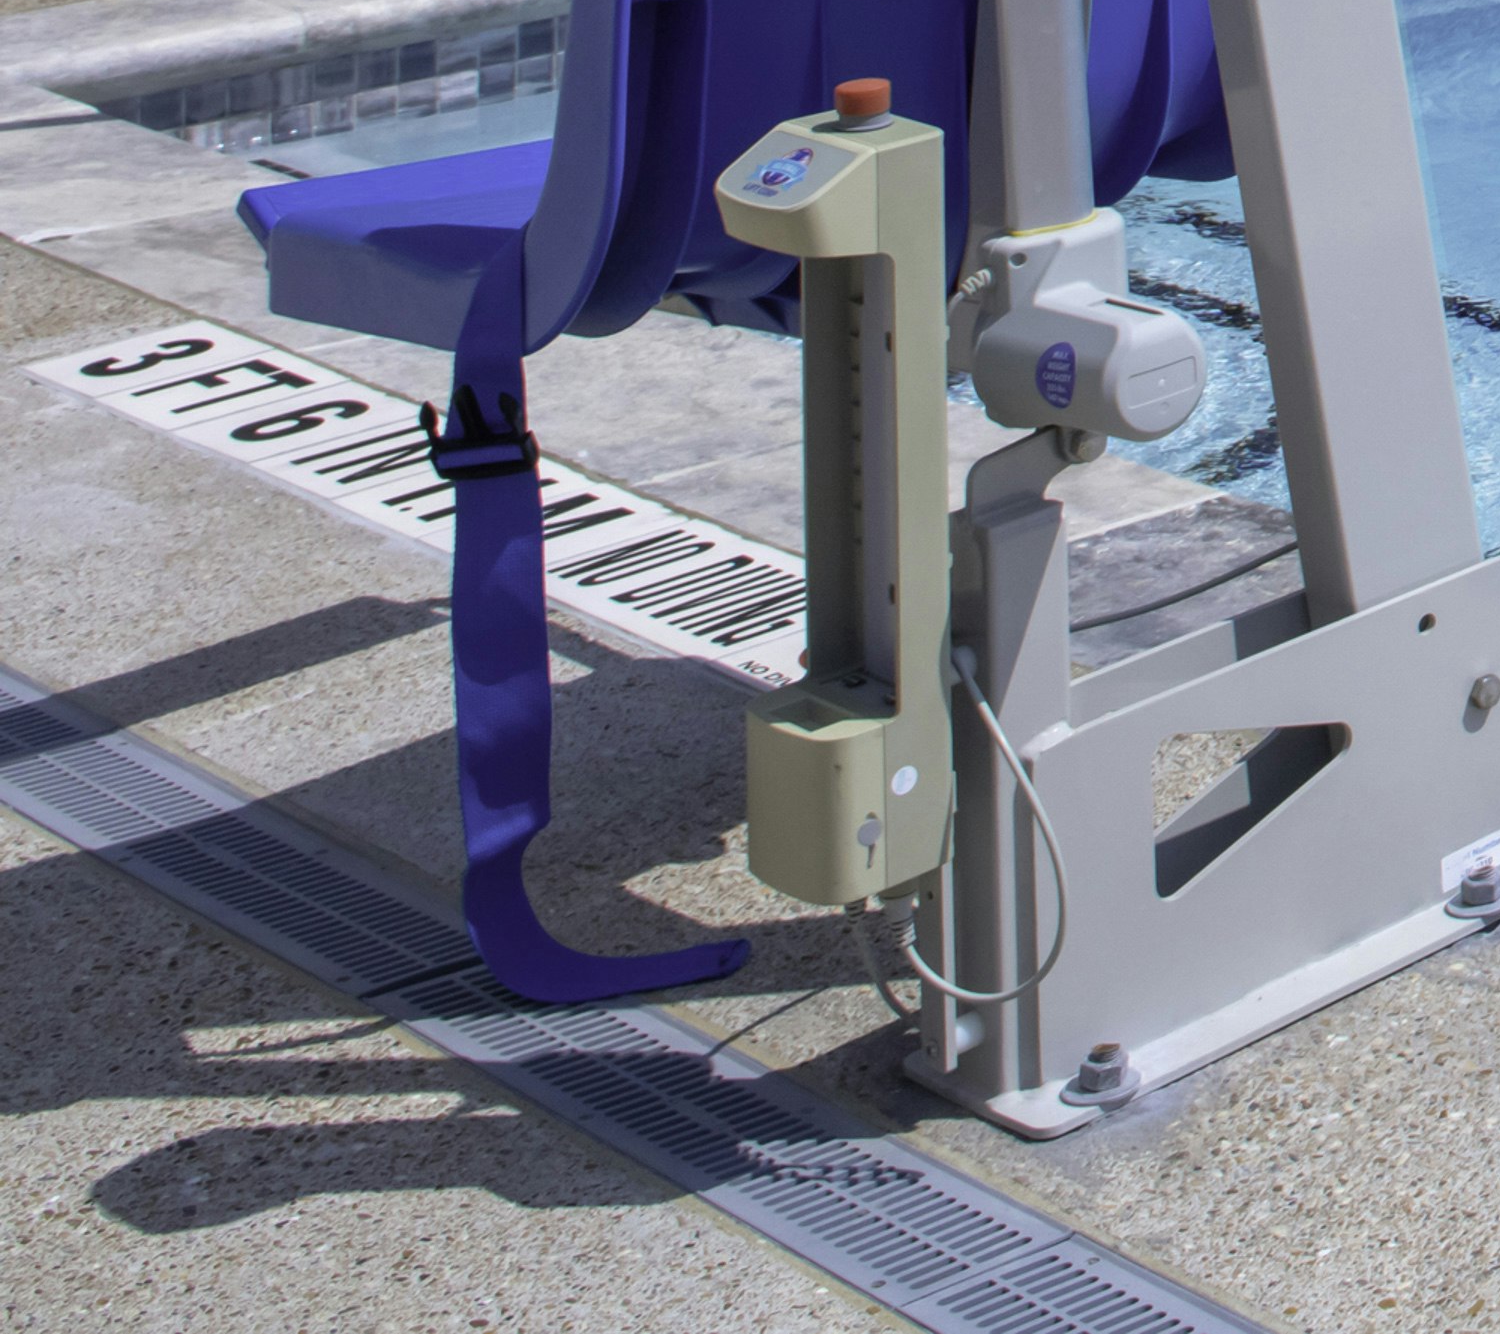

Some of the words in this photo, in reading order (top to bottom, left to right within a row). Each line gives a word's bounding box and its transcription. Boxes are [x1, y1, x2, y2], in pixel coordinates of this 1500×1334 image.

[79, 338, 214, 376] 3
[131, 359, 316, 413] FT
[230, 399, 369, 441] 6
[290, 424, 433, 484] IN
[547, 529, 716, 587] NO
[609, 555, 807, 647] DIVING
[738, 660, 770, 674] NO
